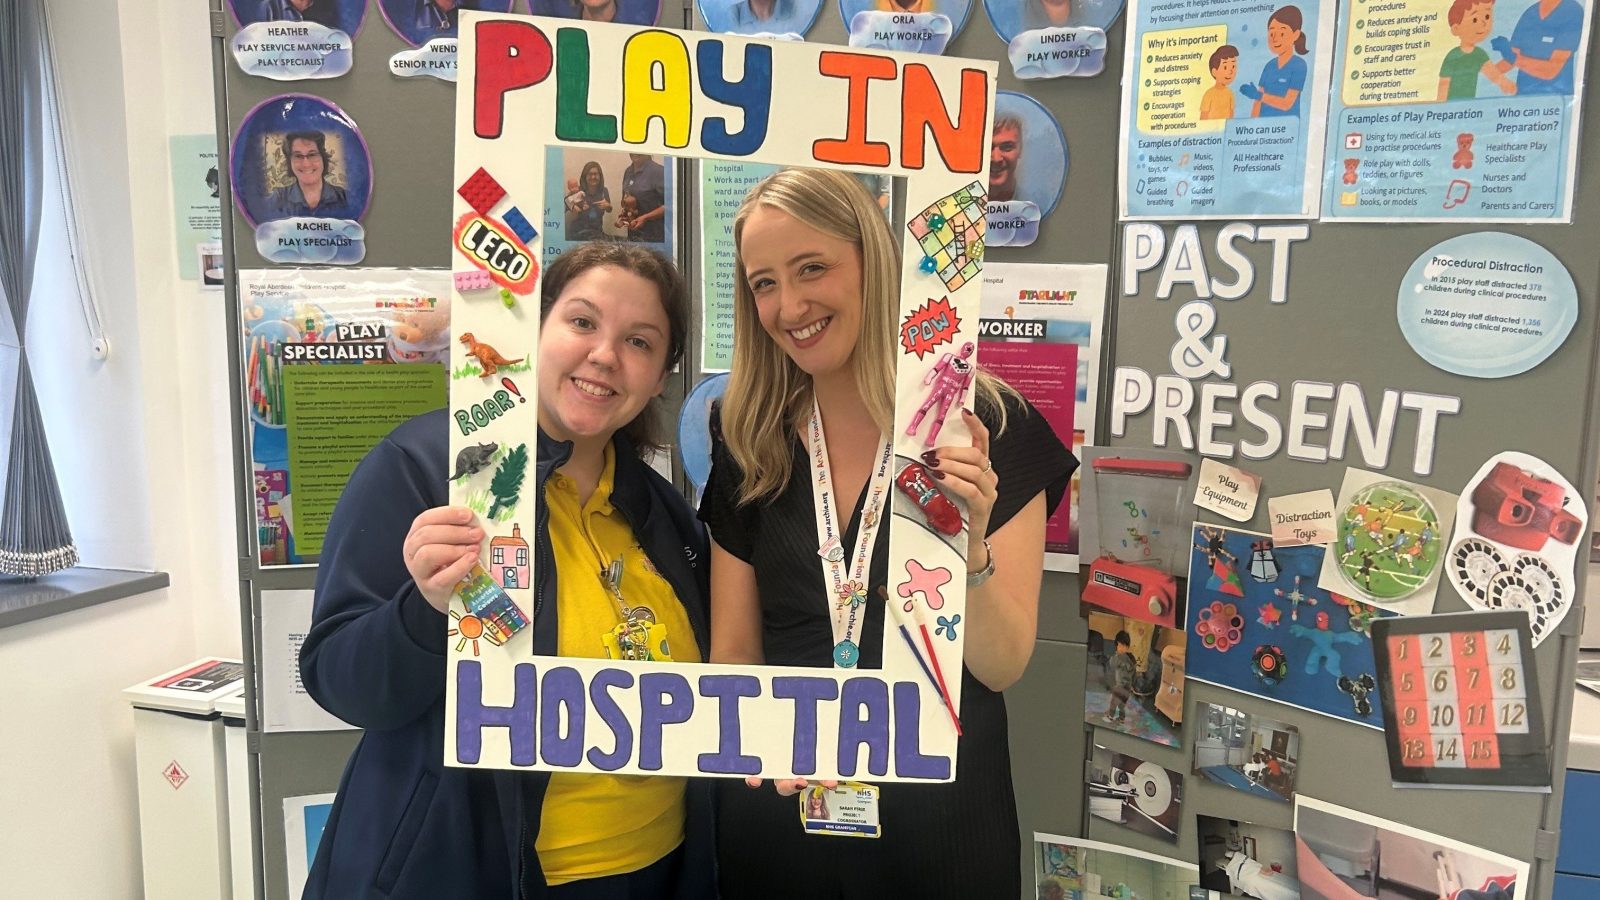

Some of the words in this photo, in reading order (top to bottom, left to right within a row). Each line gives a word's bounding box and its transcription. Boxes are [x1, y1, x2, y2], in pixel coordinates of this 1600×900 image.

[892, 15, 915, 24] ORLA
[1150, 16, 1158, 24] by
[1158, 14, 1184, 24] focusing
[1185, 12, 1199, 20] their
[1200, 9, 1230, 19] attention
[1240, 3, 1274, 14] something
[1367, 17, 1395, 27] Reduces
[1396, 15, 1422, 25] anxiety
[1423, 13, 1438, 21] and
[268, 27, 308, 36] HEATHER
[874, 32, 895, 41] PLAY
[896, 32, 932, 41] WORKER
[1366, 30, 1387, 39] builds
[1387, 27, 1411, 38] coping
[1412, 25, 1430, 34] skills
[1040, 33, 1076, 44] LINDSEY
[1148, 39, 1166, 49] Why
[1166, 37, 1176, 47] it's
[1178, 34, 1218, 46] important
[238, 44, 258, 52] PLAY
[260, 43, 295, 52] SERVICE
[297, 43, 341, 52] MANAGER
[430, 44, 458, 53] WEND
[1364, 43, 1403, 53] Encourages
[1405, 41, 1422, 49] trust
[1423, 40, 1431, 48] in
[1027, 52, 1048, 62] PLAY
[1051, 49, 1091, 60] WORKER
[1155, 54, 1180, 63] Reduces
[1180, 51, 1203, 61] anxiety
[1363, 56, 1380, 64] staff
[1380, 55, 1394, 63] and
[1395, 53, 1416, 62] carers
[258, 58, 280, 66] PLAY
[281, 58, 325, 66] SPECIALIST
[394, 60, 427, 69] SENIOR
[429, 60, 453, 69] PLAY
[1154, 65, 1165, 74] and
[1166, 63, 1189, 73] distress
[1362, 69, 1393, 79] Supports
[1393, 67, 1416, 76] better
[1361, 80, 1401, 90] cooperation
[474, 19, 773, 157] PLAY
[812, 51, 988, 174] IN
[1359, 91, 1382, 101] during
[1383, 90, 1419, 99] treatment
[1347, 113, 1389, 125] Examples
[1390, 112, 1402, 122] of
[1403, 111, 1423, 124] Play
[1426, 109, 1483, 122] Preparation
[1497, 107, 1522, 118] Who
[1523, 108, 1541, 117] can
[1543, 107, 1560, 117] use
[1235, 125, 1254, 135] Who
[1255, 126, 1270, 134] can
[1271, 125, 1286, 134] use
[1496, 121, 1559, 134] Preparation?
[1138, 139, 1173, 150] Examples
[1173, 137, 1181, 147] of
[1181, 136, 1222, 147] distraction
[1486, 142, 1529, 152] Healthcare
[1530, 142, 1548, 153] Play
[1233, 153, 1243, 162] All
[1244, 152, 1284, 162] Healthcare
[1485, 153, 1526, 164] Specialists
[714, 164, 744, 174] hospital
[1233, 163, 1281, 173] Professionals
[743, 177, 760, 186] part
[1482, 173, 1510, 182] Nurses
[1511, 172, 1526, 182] and
[714, 188, 732, 196] ward
[733, 188, 748, 196] and
[1481, 184, 1513, 193] Doctors
[723, 199, 740, 209] help
[987, 205, 1010, 214] IDAN
[1480, 201, 1510, 211] Parents
[1511, 201, 1528, 210] and
[1528, 201, 1554, 211] Carers
[296, 222, 333, 231] RACHEL
[988, 220, 1026, 230] WORKER
[278, 238, 301, 247] PLAY
[304, 238, 352, 247] SPECIALIST
[1122, 222, 1310, 304] PAST
[1431, 256, 1486, 270] Procedural
[1489, 260, 1543, 274] Distraction
[716, 272, 731, 280] play
[983, 277, 1004, 285] Hospital
[1439, 276, 1456, 285] 2015
[1457, 278, 1473, 287] play
[1474, 278, 1490, 286] staff
[1491, 281, 1527, 290] distracted
[1019, 289, 1077, 301] STARLIGHT
[1424, 284, 1452, 294] children
[1453, 286, 1476, 297] during
[1478, 288, 1504, 298] clinical
[1505, 291, 1547, 303] procedures
[1433, 309, 1450, 318] 2024
[1450, 311, 1466, 321] play
[1467, 312, 1483, 321] staff
[1484, 314, 1520, 325] distracted
[338, 324, 380, 340] PLAY
[716, 322, 734, 330] Offer
[907, 310, 951, 348] POW
[978, 319, 1044, 338] WORKER
[1421, 317, 1448, 327] children
[1450, 319, 1472, 330] during
[1474, 321, 1500, 332] clinical
[1501, 324, 1543, 337] procedures
[1169, 299, 1231, 379] &
[284, 344, 385, 361] SPECIALIST
[716, 351, 727, 359] fun
[454, 377, 526, 436] ROAR!
[1111, 366, 1461, 477] PRESENT
[1218, 474, 1239, 493] Play
[1202, 486, 1248, 511] Equipment
[1275, 510, 1332, 524] Distraction
[1293, 528, 1318, 542] Toys
[1398, 640, 1409, 660] 1
[1428, 637, 1444, 659] 2
[1460, 635, 1477, 657] 3
[1497, 634, 1512, 654] 4
[1400, 673, 1413, 692] 5
[1432, 670, 1448, 691] 6
[1467, 669, 1479, 689] 7
[1500, 667, 1517, 688] 8
[456, 659, 951, 780] HOSPITAL
[1403, 707, 1417, 725] 9
[1431, 706, 1454, 727] 10
[1465, 706, 1486, 726] 11
[1501, 703, 1525, 725] 12
[1404, 740, 1424, 760] 13
[1436, 740, 1457, 761] 14
[1470, 740, 1492, 760] 15
